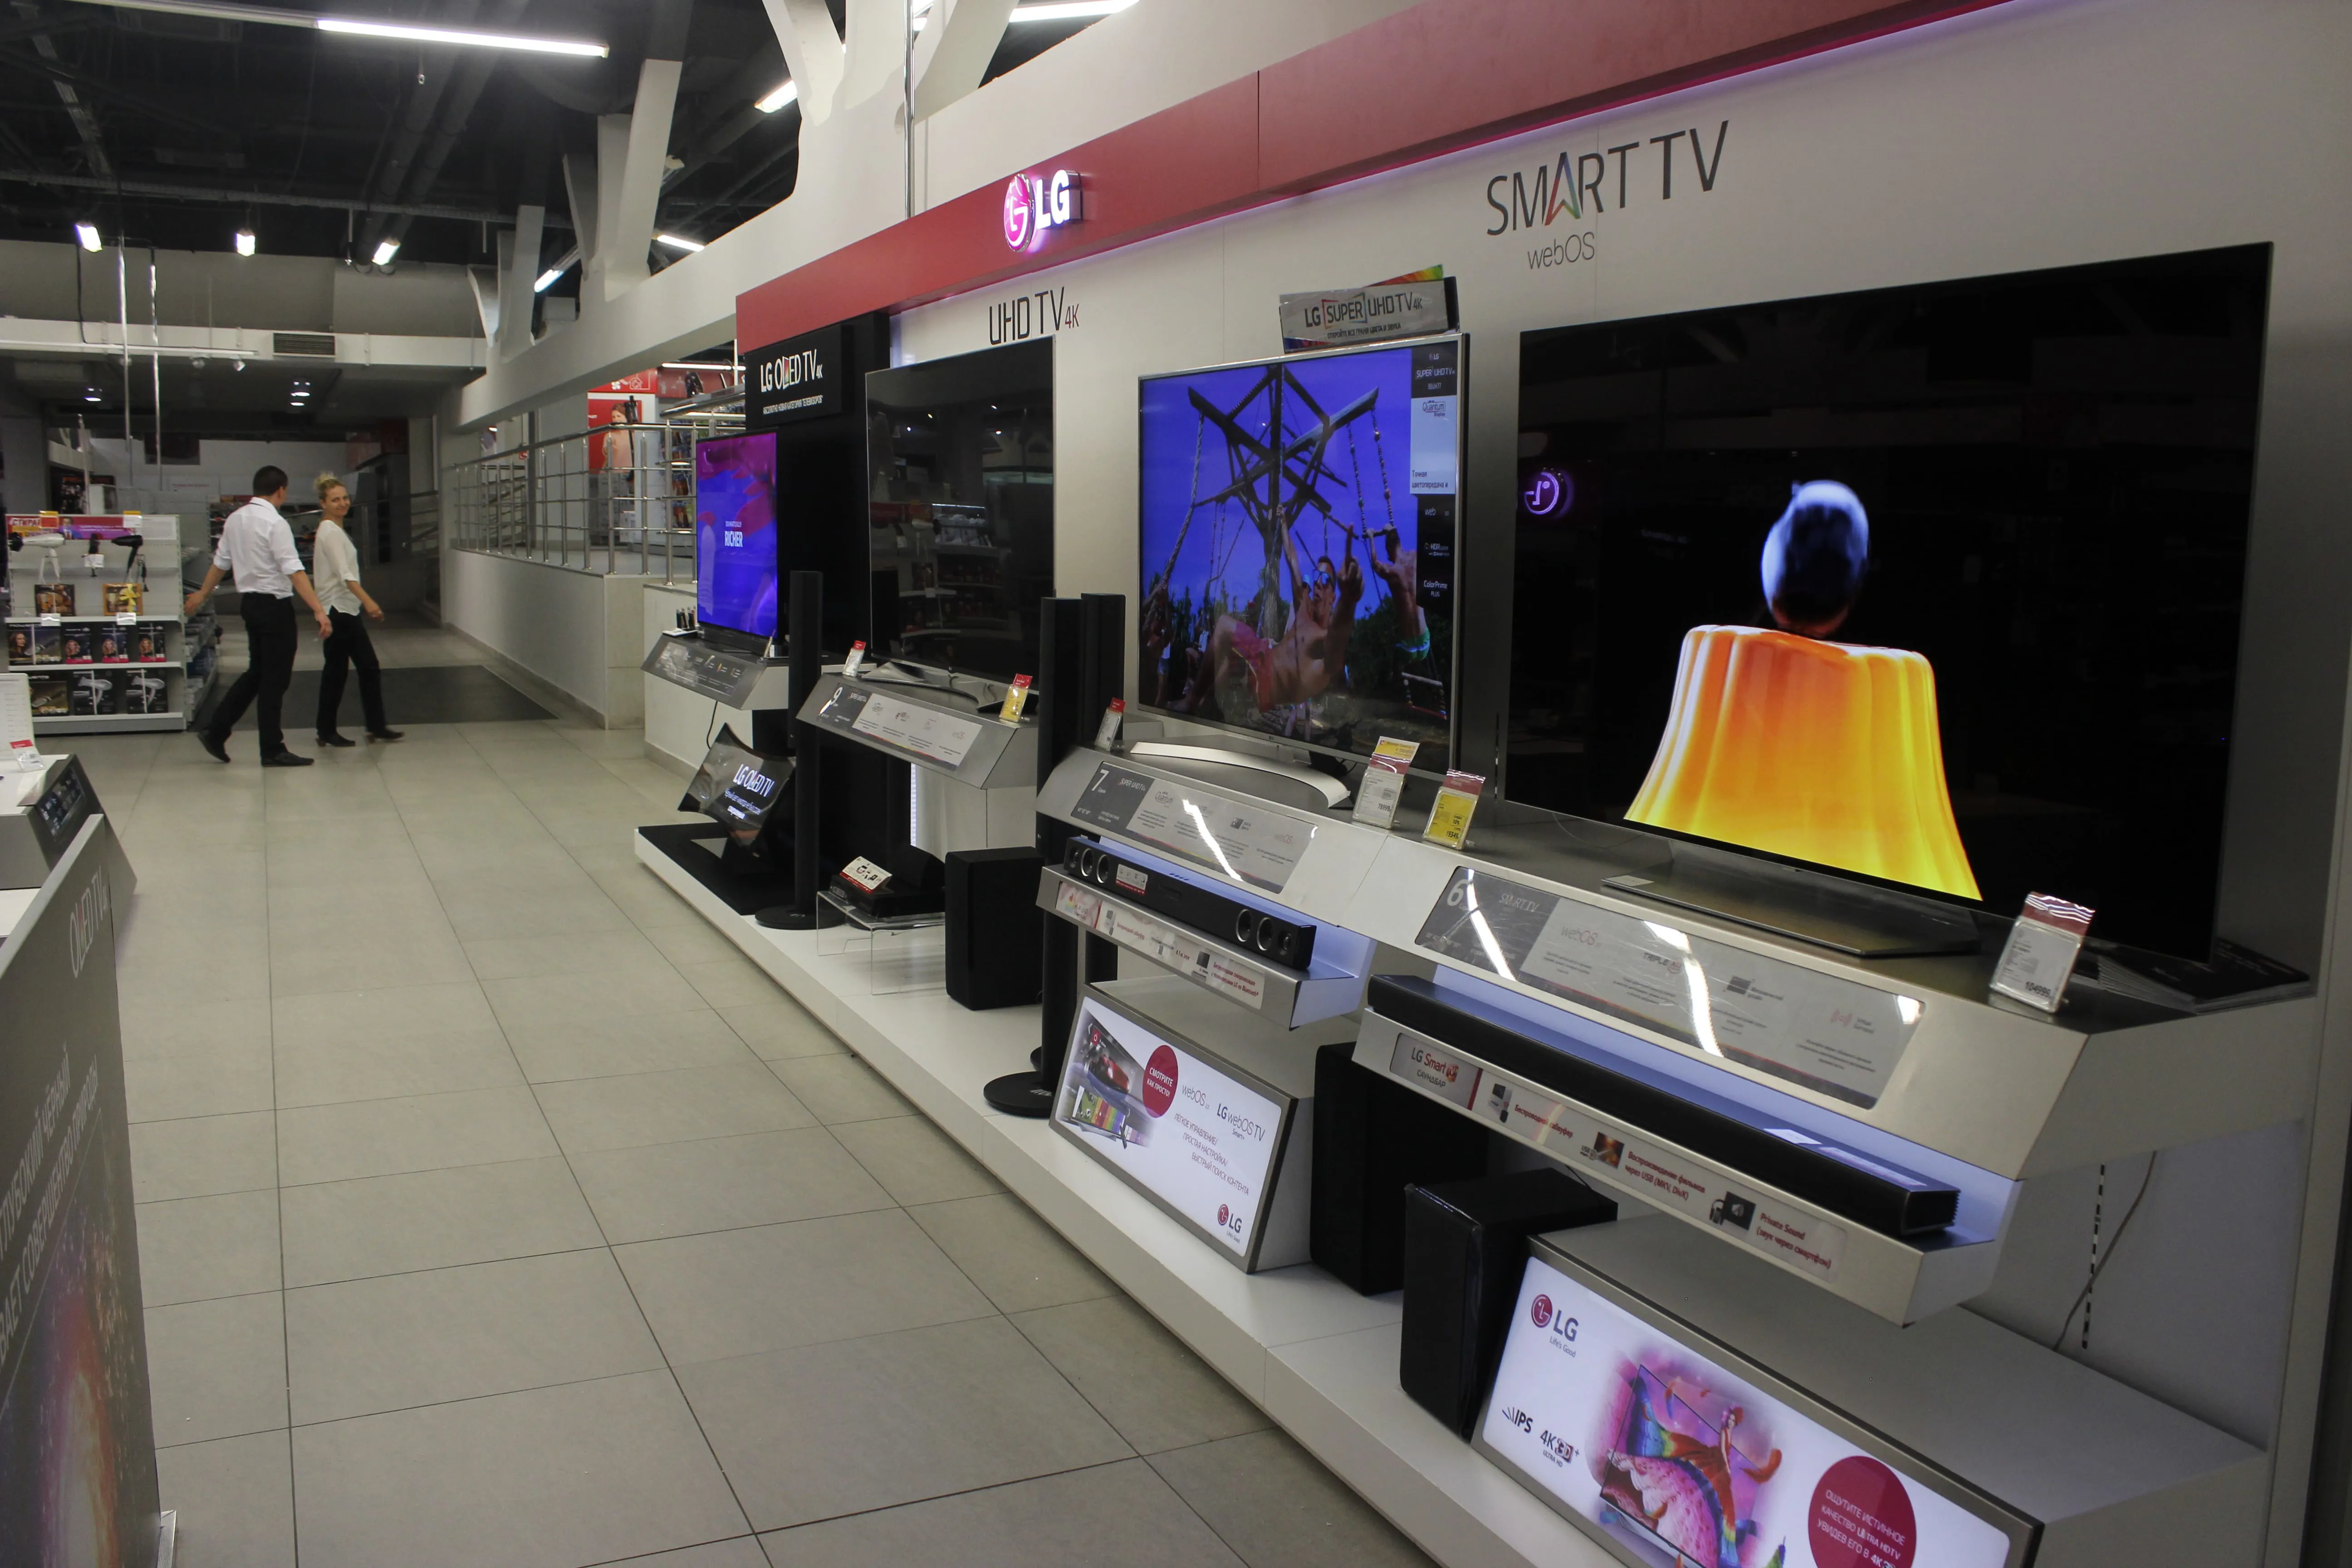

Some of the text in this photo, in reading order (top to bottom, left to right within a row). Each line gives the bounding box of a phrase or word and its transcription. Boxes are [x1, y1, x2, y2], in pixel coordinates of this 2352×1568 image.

[1486, 120, 1729, 236] SMART TV
[1036, 169, 1070, 229] LG
[1527, 231, 1595, 270] webOS
[989, 296, 1030, 345] UHD
[1065, 304, 1079, 329] 4K
[1304, 307, 1321, 328] LG
[1327, 301, 1363, 323] SUPER
[1368, 296, 1395, 317] UHD
[1327, 329, 1348, 339] ОТКРОЙТЕ
[1370, 325, 1383, 334] ЦВЕТА
[1387, 323, 1401, 331] ЗВУКА
[760, 362, 772, 392] LG
[774, 354, 801, 390] OLED
[1416, 369, 1432, 377] SUPER
[1434, 368, 1445, 376] UHD
[725, 530, 743, 547] RICHER
[1424, 580, 1447, 589] ColorPrime
[733, 764, 775, 797] LG OLED TV
[1091, 769, 1109, 791] 7
[1447, 879, 1468, 906] 6
[69, 887, 93, 978] OLED
[1643, 952, 1668, 966] TRIPLE
[1411, 1047, 1423, 1063] LG
[1424, 1053, 1446, 1073] Smart
[1147, 1078, 1171, 1098] КАК ПРОСТО!
[1149, 1067, 1173, 1087] СМОТРИТЕ
[1417, 1069, 1446, 1088] САУНДБАР
[42, 1041, 70, 1142] ЧЁРНЫЙ
[1182, 1085, 1206, 1107] webOS
[1216, 1103, 1265, 1142] LG webOS TV
[1549, 1123, 1573, 1139] сабвуфер
[1183, 1132, 1201, 1149] ПРОСТАЯ
[1191, 1152, 1249, 1196] БЫСТРЫЙ ПОИСК КОНТЕНТА
[1625, 1165, 1641, 1176] через
[1642, 1171, 1654, 1183] USB
[1628, 1151, 1705, 1193] Воспроизведение фильмов
[0, 1263, 22, 1368] ВАЕТ
[73, 1054, 98, 1147] ПРИРОДЫ
[1229, 1213, 1242, 1233] LG
[1757, 1226, 1774, 1240] (звук
[1775, 1236, 1793, 1250] через
[1761, 1213, 1805, 1240] Private Sound
[1553, 1309, 1579, 1342] LG
[1550, 1336, 1577, 1358] Life's Good
[1514, 1409, 1533, 1433] IPS
[1540, 1430, 1557, 1450] 4K
[1543, 1450, 1563, 1468] ULTRA HD
[1826, 1489, 1905, 1546] ОЩУТИТЕ ИСТИННОЕ
[1817, 1518, 1847, 1544] УВИДЕВ
[1847, 1538, 1862, 1554] ЕГО
[1863, 1548, 1870, 1558] В
[1871, 1554, 1883, 1568] 4K
[1821, 1504, 1901, 1560] КАЧЕСТВО ULTRA HDTV
